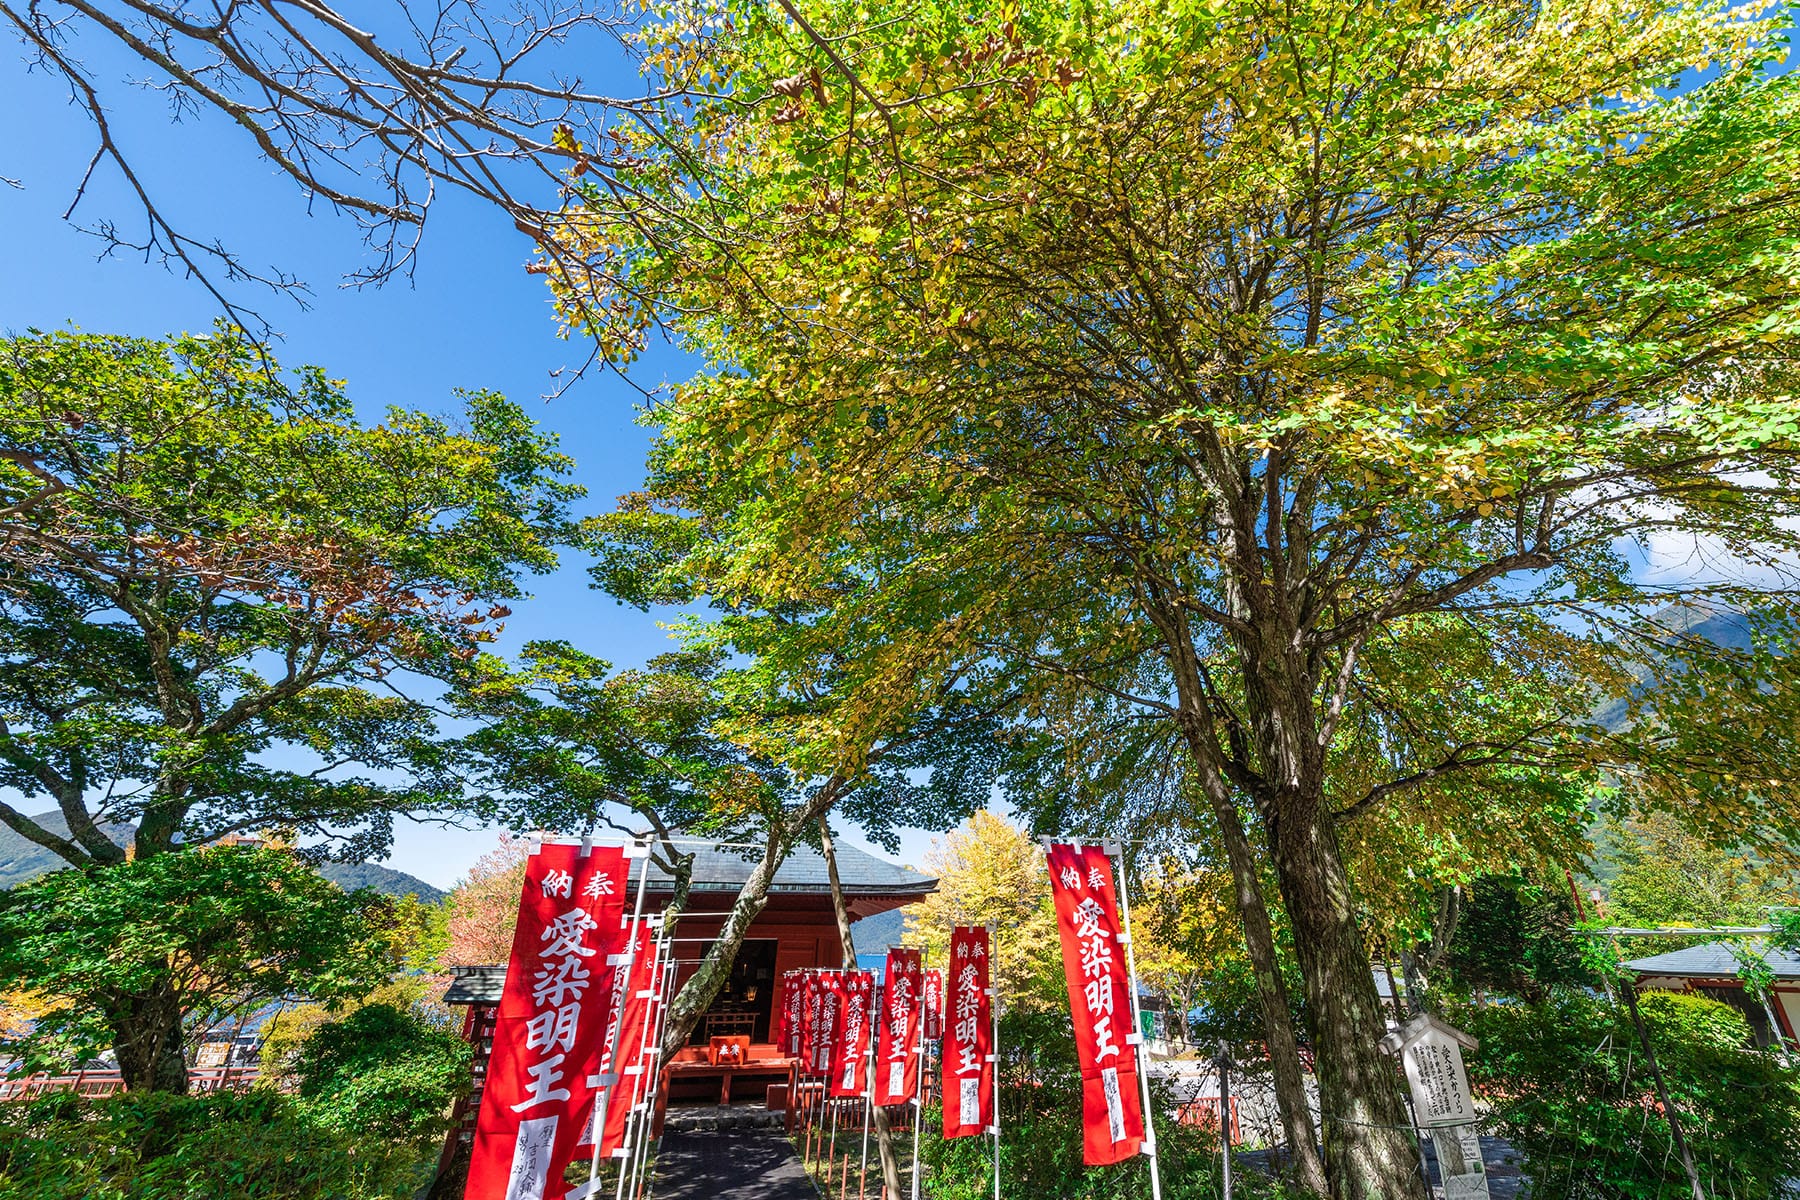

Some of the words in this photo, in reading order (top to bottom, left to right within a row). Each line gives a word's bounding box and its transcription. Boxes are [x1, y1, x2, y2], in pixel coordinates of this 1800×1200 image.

[510, 907, 598, 1113] 愛染明王
[819, 992, 837, 1046] 愛染明王
[843, 994, 865, 1062] 愛染明王
[888, 977, 912, 1060] 愛染明王
[954, 964, 982, 1075] 愛染明王
[1073, 896, 1119, 1064] 愛染明王
